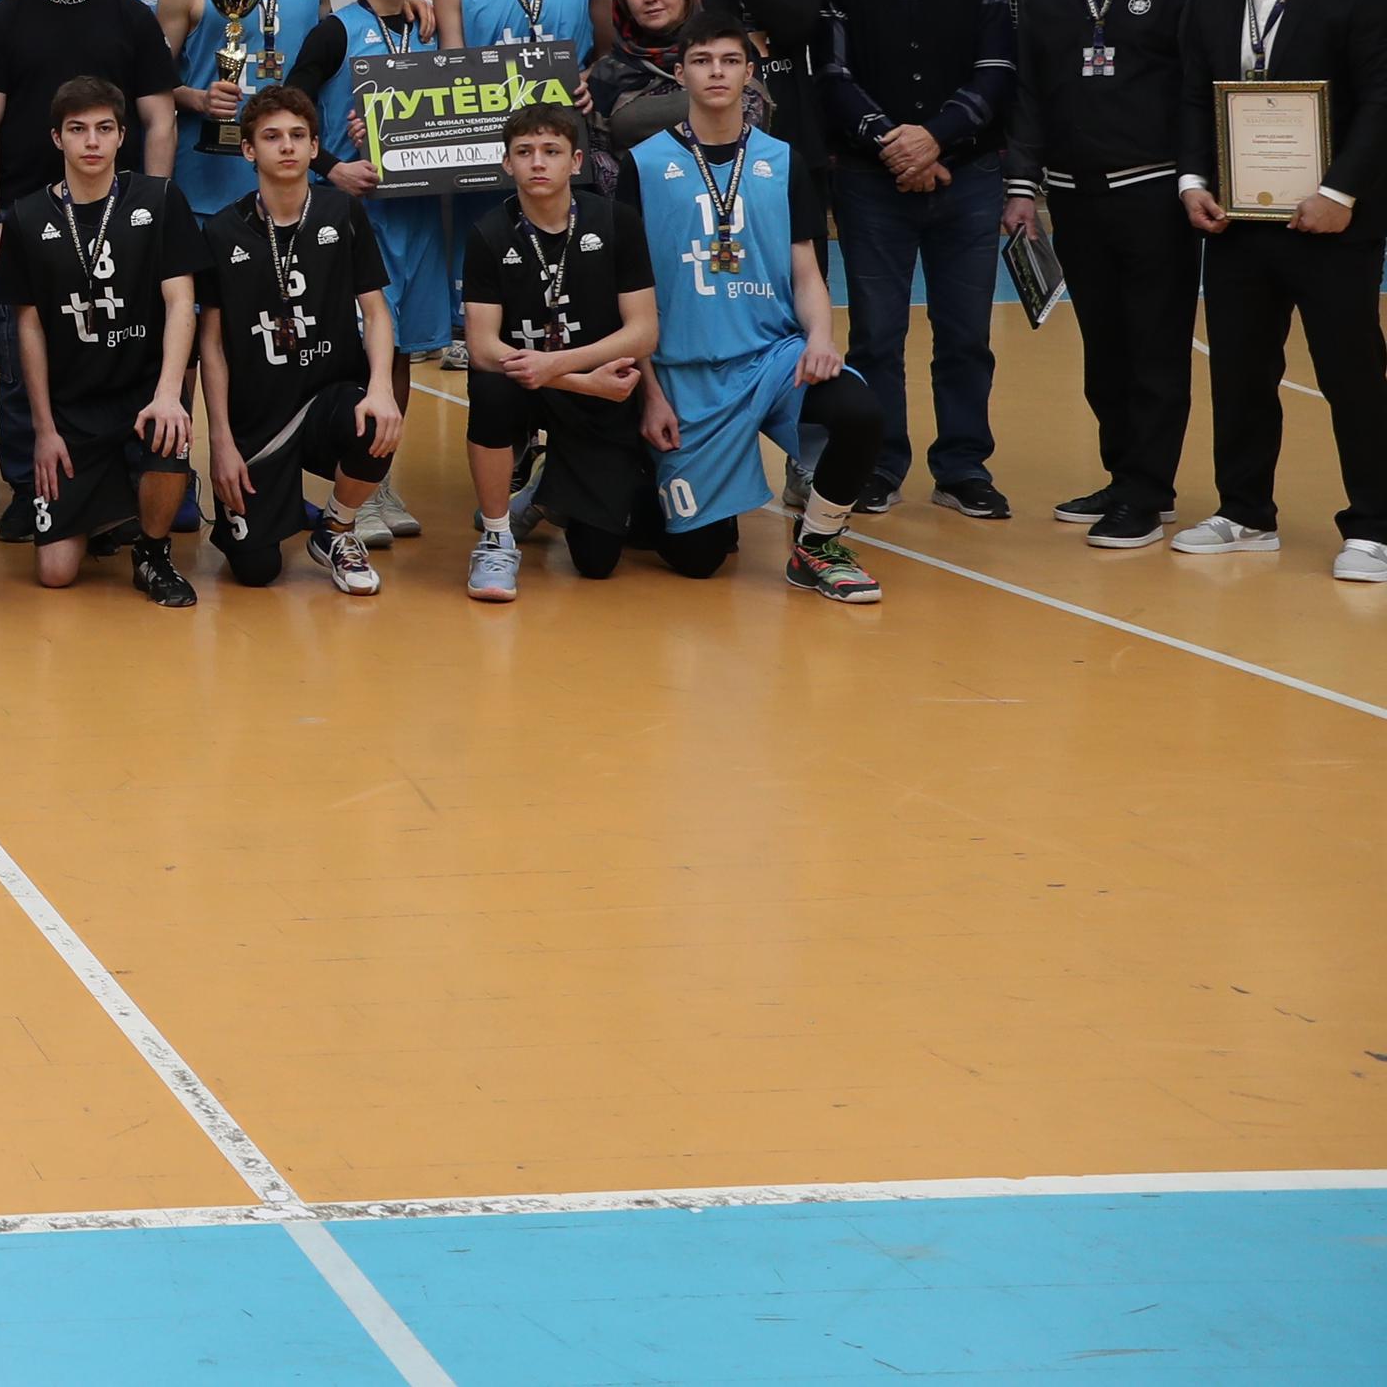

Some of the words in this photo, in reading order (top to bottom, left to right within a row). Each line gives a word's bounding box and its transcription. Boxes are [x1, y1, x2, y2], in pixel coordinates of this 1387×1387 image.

[362, 74, 575, 122] ПУТЁВКА
[424, 120, 435, 128] НА
[436, 119, 464, 127] ФИНАЛ
[465, 116, 511, 125] ЧЕМПИОНА
[390, 127, 473, 143] СЕВЕРО-КАВКАЗСКОГО
[728, 278, 776, 299] group
[107, 323, 147, 348] group
